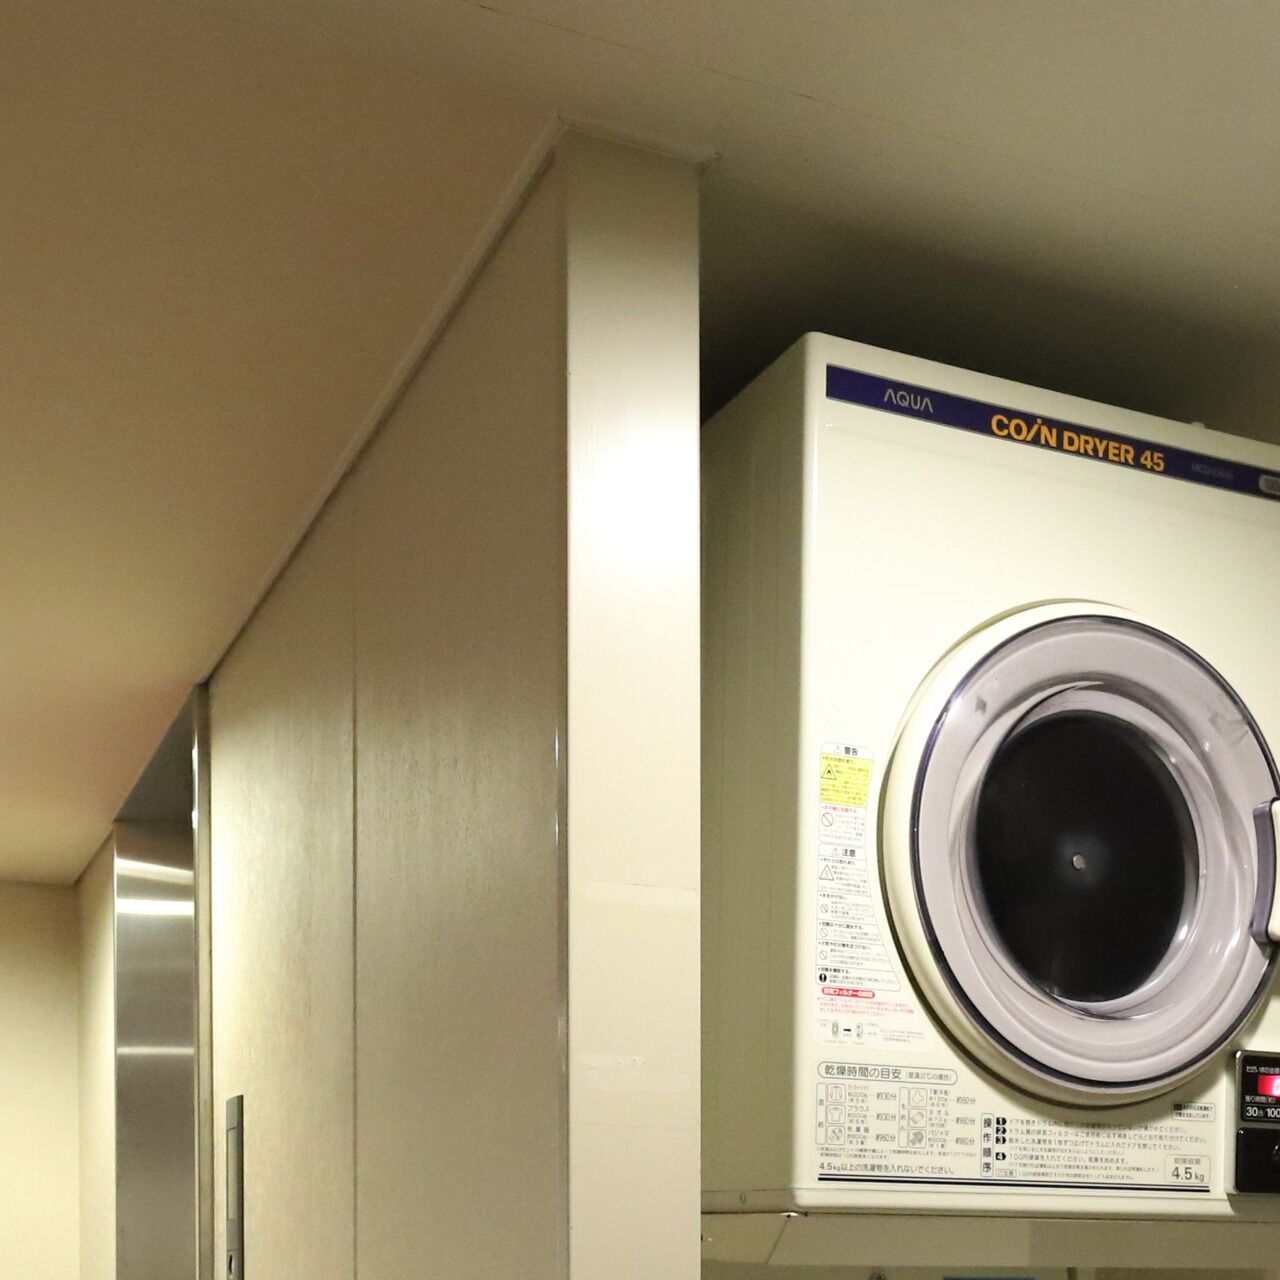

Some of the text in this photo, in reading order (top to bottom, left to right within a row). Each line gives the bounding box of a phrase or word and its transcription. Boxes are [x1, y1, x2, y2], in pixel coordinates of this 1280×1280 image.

[884, 388, 934, 413] AQUA
[991, 414, 1165, 472] COIN DRYER 45
[824, 1064, 902, 1080] 乾燥時間の目安
[983, 1117, 992, 1173] 操作順序
